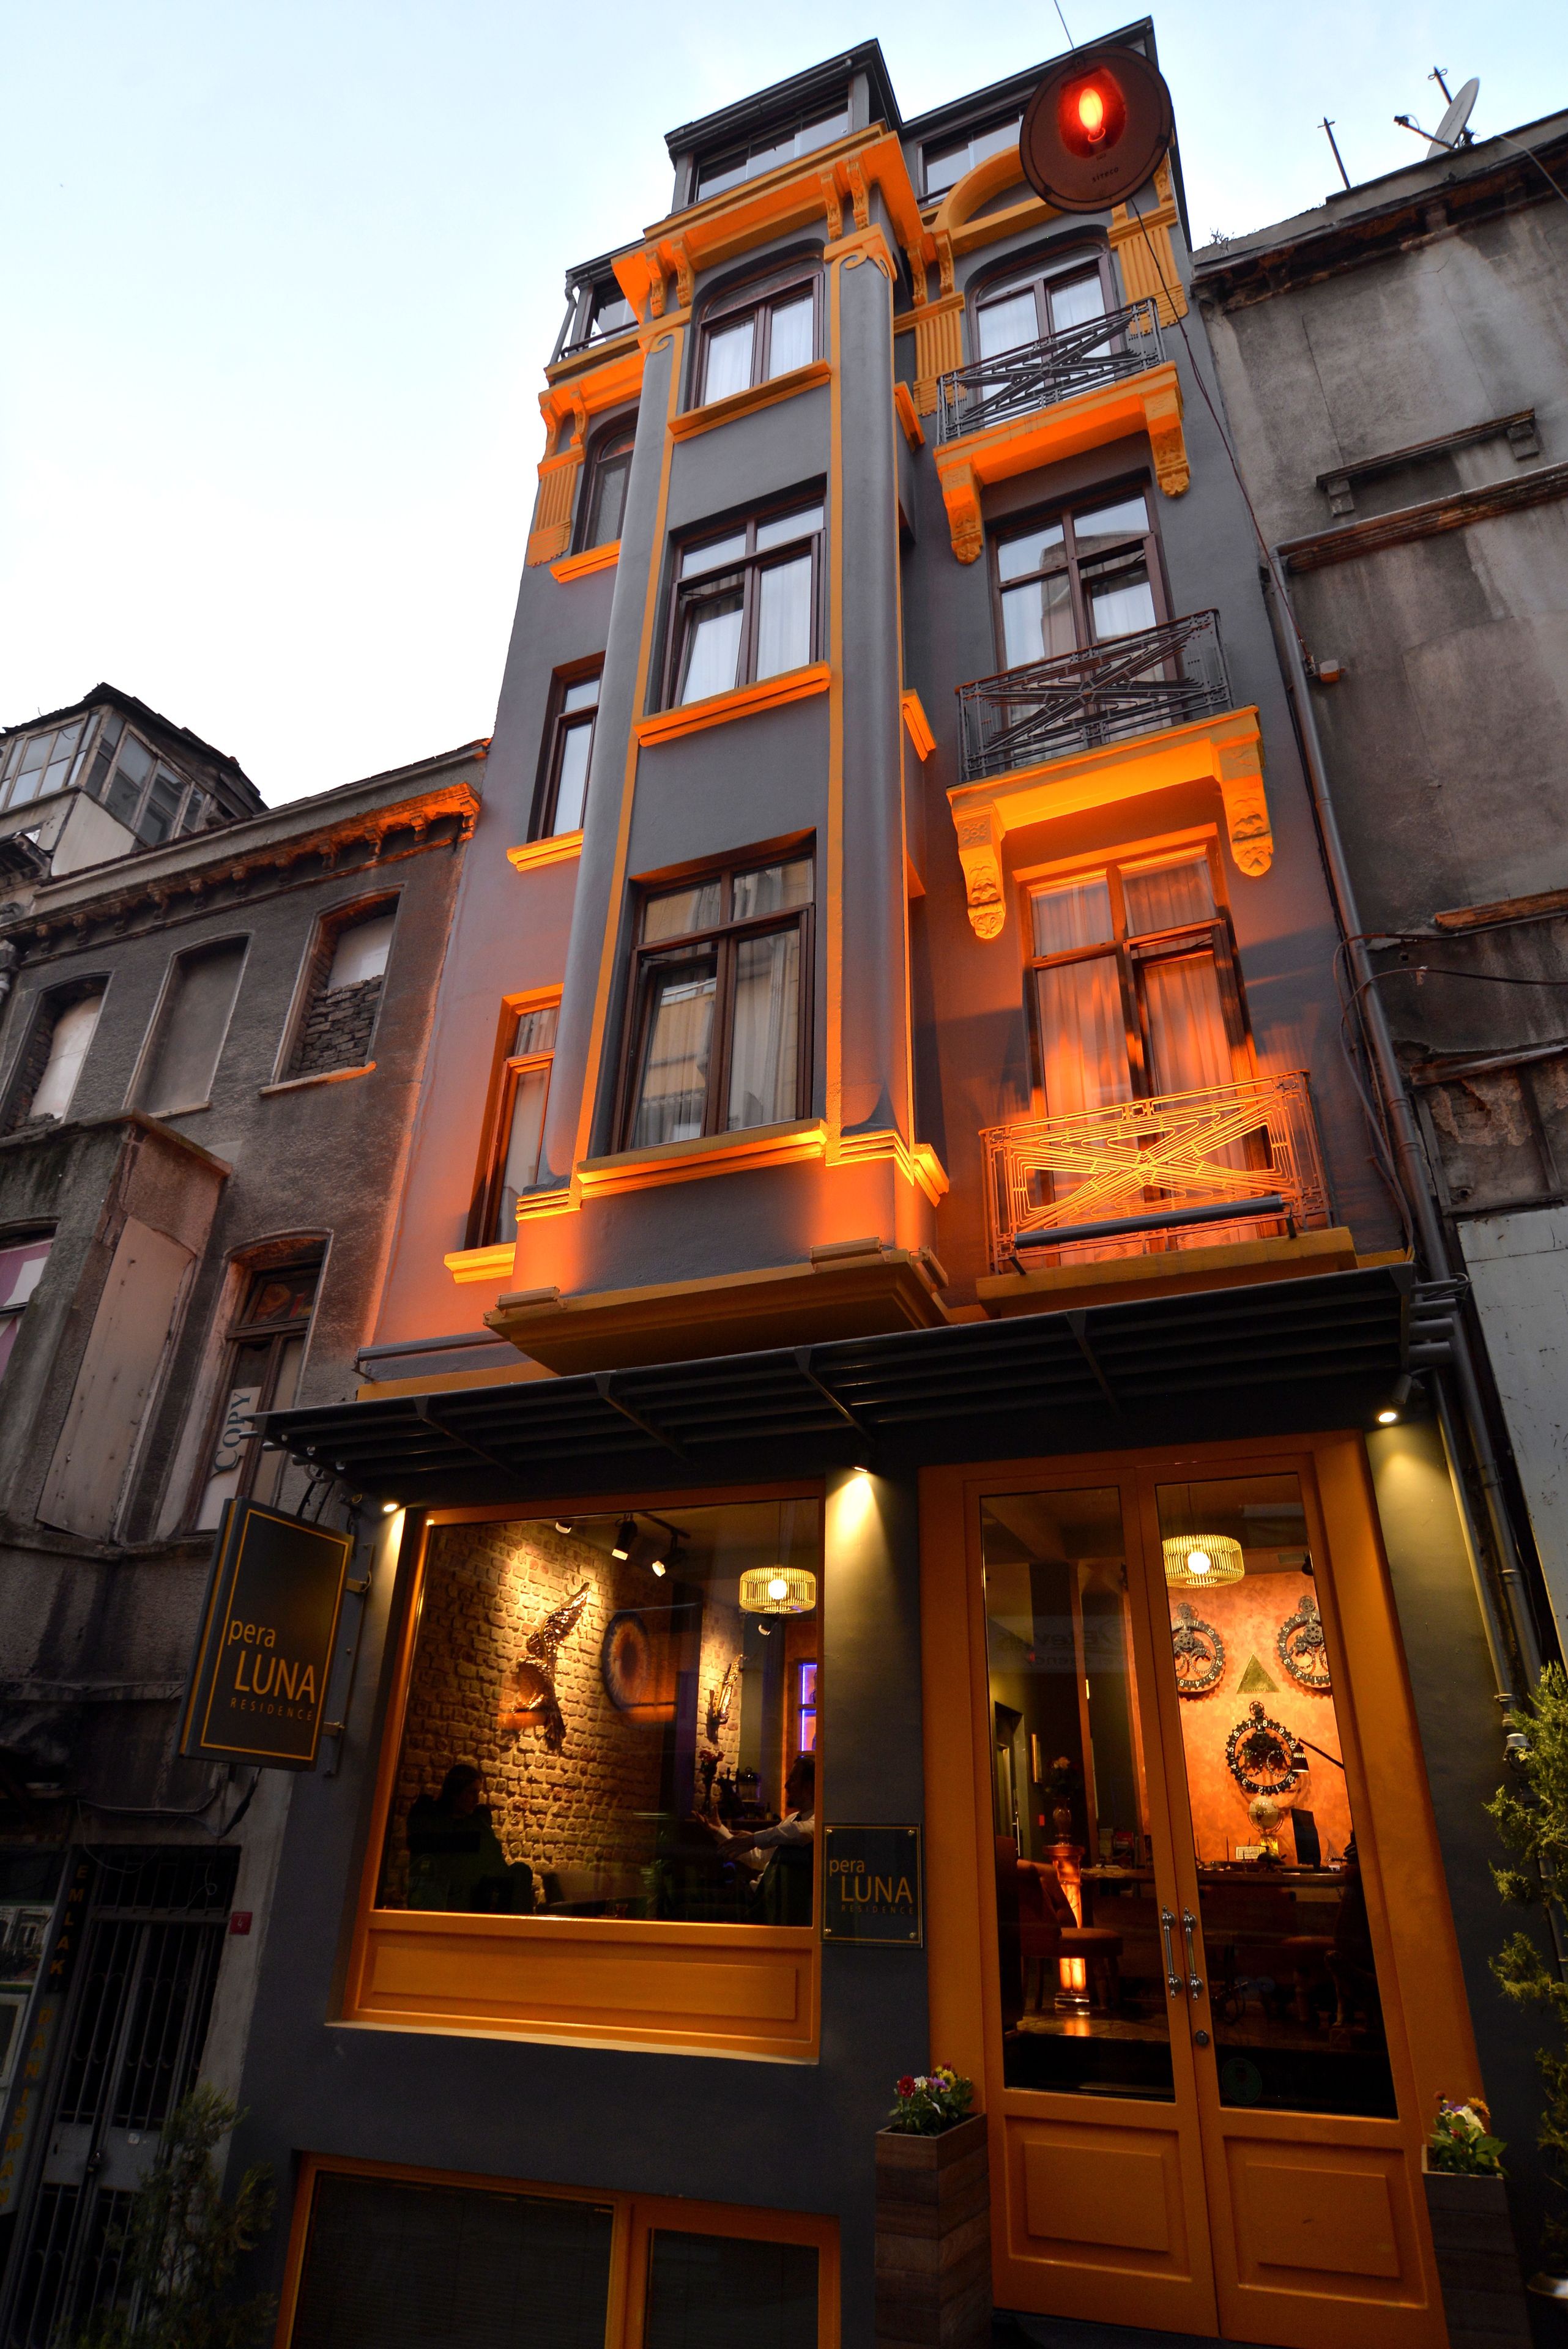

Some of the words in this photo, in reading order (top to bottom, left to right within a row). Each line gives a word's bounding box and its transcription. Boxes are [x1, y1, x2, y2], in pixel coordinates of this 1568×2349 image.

[215, 1392, 251, 1471] COPY
[227, 1620, 277, 1648] pera
[234, 1650, 316, 1704] LUNA
[230, 1698, 314, 1721] RESIDENCE
[1288, 1740, 1296, 1749] 10
[1286, 1775, 1295, 1783] 12
[829, 1860, 865, 1877] pera
[841, 1876, 913, 1904] LUNA
[50, 1865, 89, 1976] EMLAK
[841, 1905, 914, 1915] RESIDENCE
[237, 1917, 243, 1928] 4
